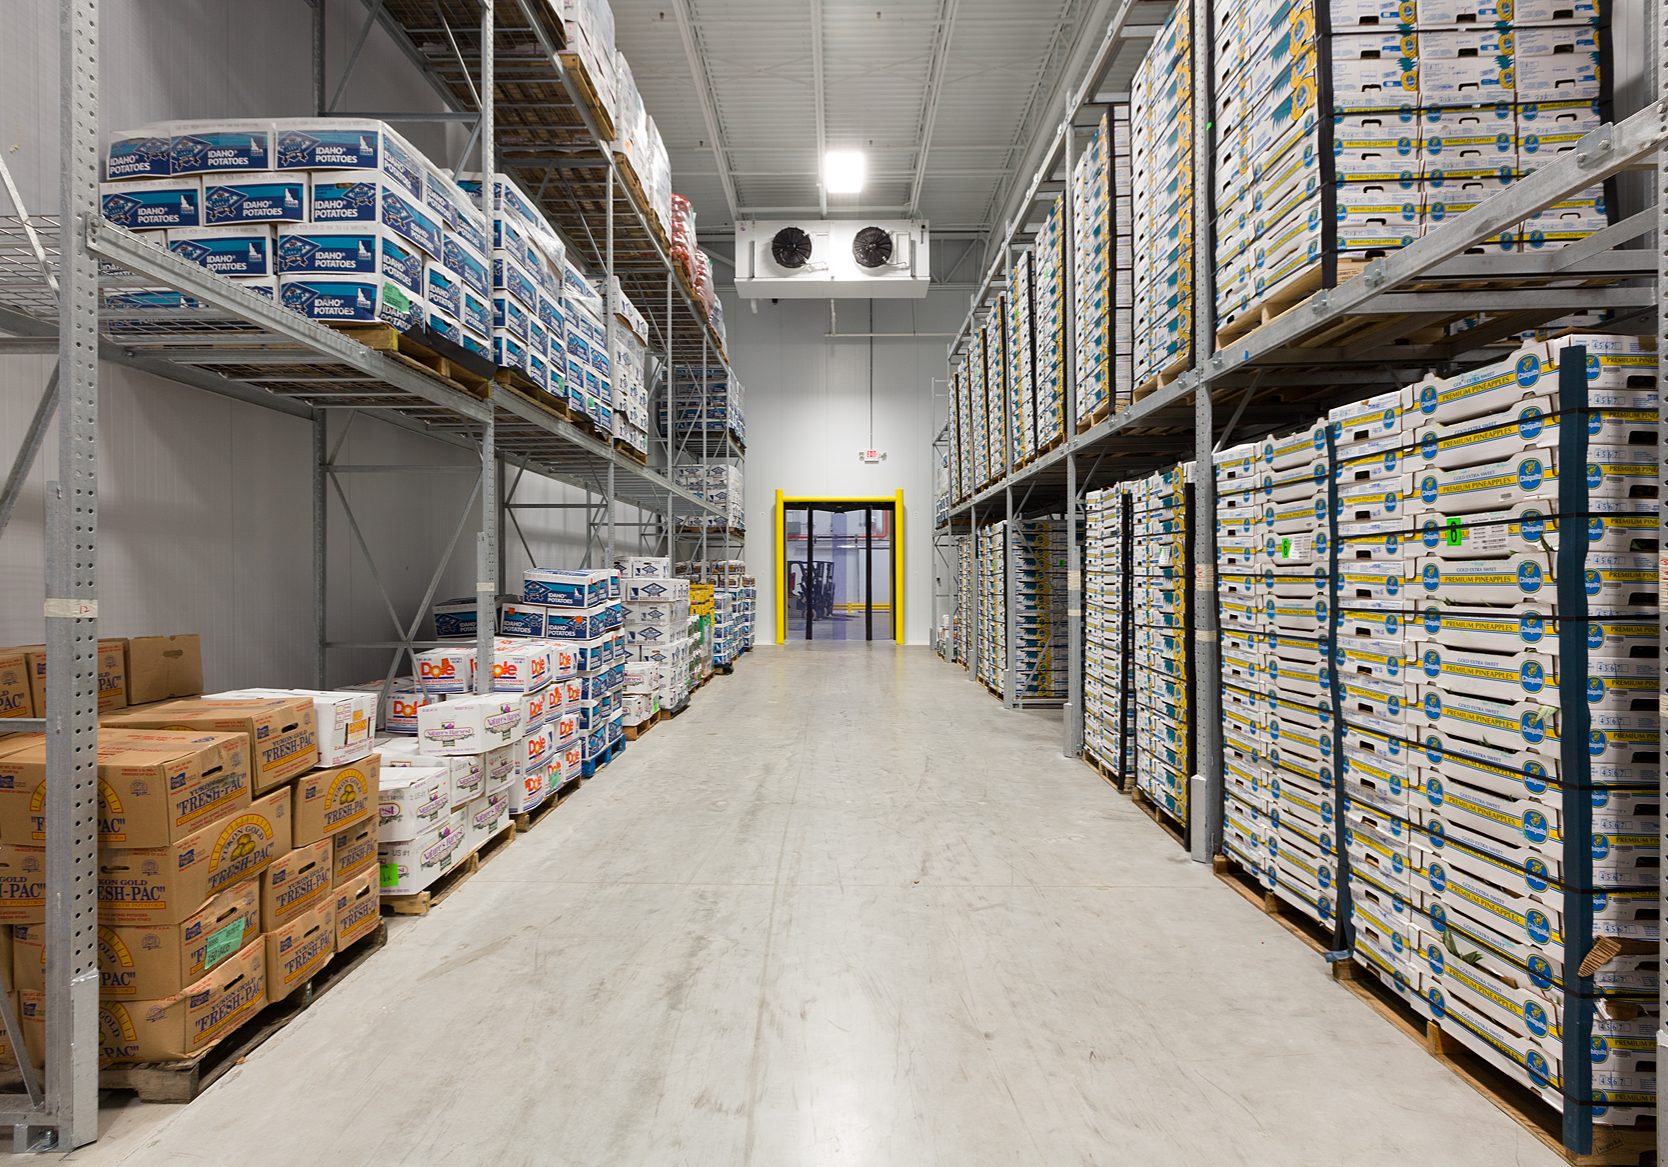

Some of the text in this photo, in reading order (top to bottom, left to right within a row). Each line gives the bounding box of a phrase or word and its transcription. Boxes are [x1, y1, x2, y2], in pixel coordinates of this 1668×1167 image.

[208, 150, 234, 158] IDAHO
[315, 147, 341, 155] IDAHO
[110, 155, 136, 165] IDAHO
[208, 157, 248, 166] POTATOES
[315, 154, 358, 163] POTATOES
[109, 163, 150, 174] POTATOES
[243, 201, 270, 209] IDAHO
[315, 200, 341, 210] IDAHO
[138, 207, 164, 216] IDAHO
[243, 207, 283, 216] POTATOES
[314, 208, 358, 218] POTATOES
[138, 214, 179, 223] POTATOES
[207, 255, 232, 264] IDAHO
[315, 252, 341, 260] IDAHO
[315, 260, 356, 268] POTATOES
[314, 299, 340, 308] IDAHO
[314, 306, 355, 316] POTATOES
[1442, 377, 1510, 401] PREMIUM PINEAPPLES
[1443, 427, 1512, 447] PREMIUM PINEAPPLES
[1443, 477, 1511, 493] PREMIUM PINEAPPLES
[1474, 575, 1511, 583] PINEAPPLES
[1446, 620, 1513, 631] PREMIUM PINEAPPLES
[559, 652, 572, 668] Dole
[531, 657, 546, 675] Dole
[1446, 665, 1514, 680] PREMIUM PINEAPPLES
[1447, 709, 1514, 729] PREMIUM PINEAPPLES
[559, 718, 573, 735] Dole
[529, 735, 546, 755] Dole
[1449, 796, 1517, 825] PREMIUM PINEAPPLES
